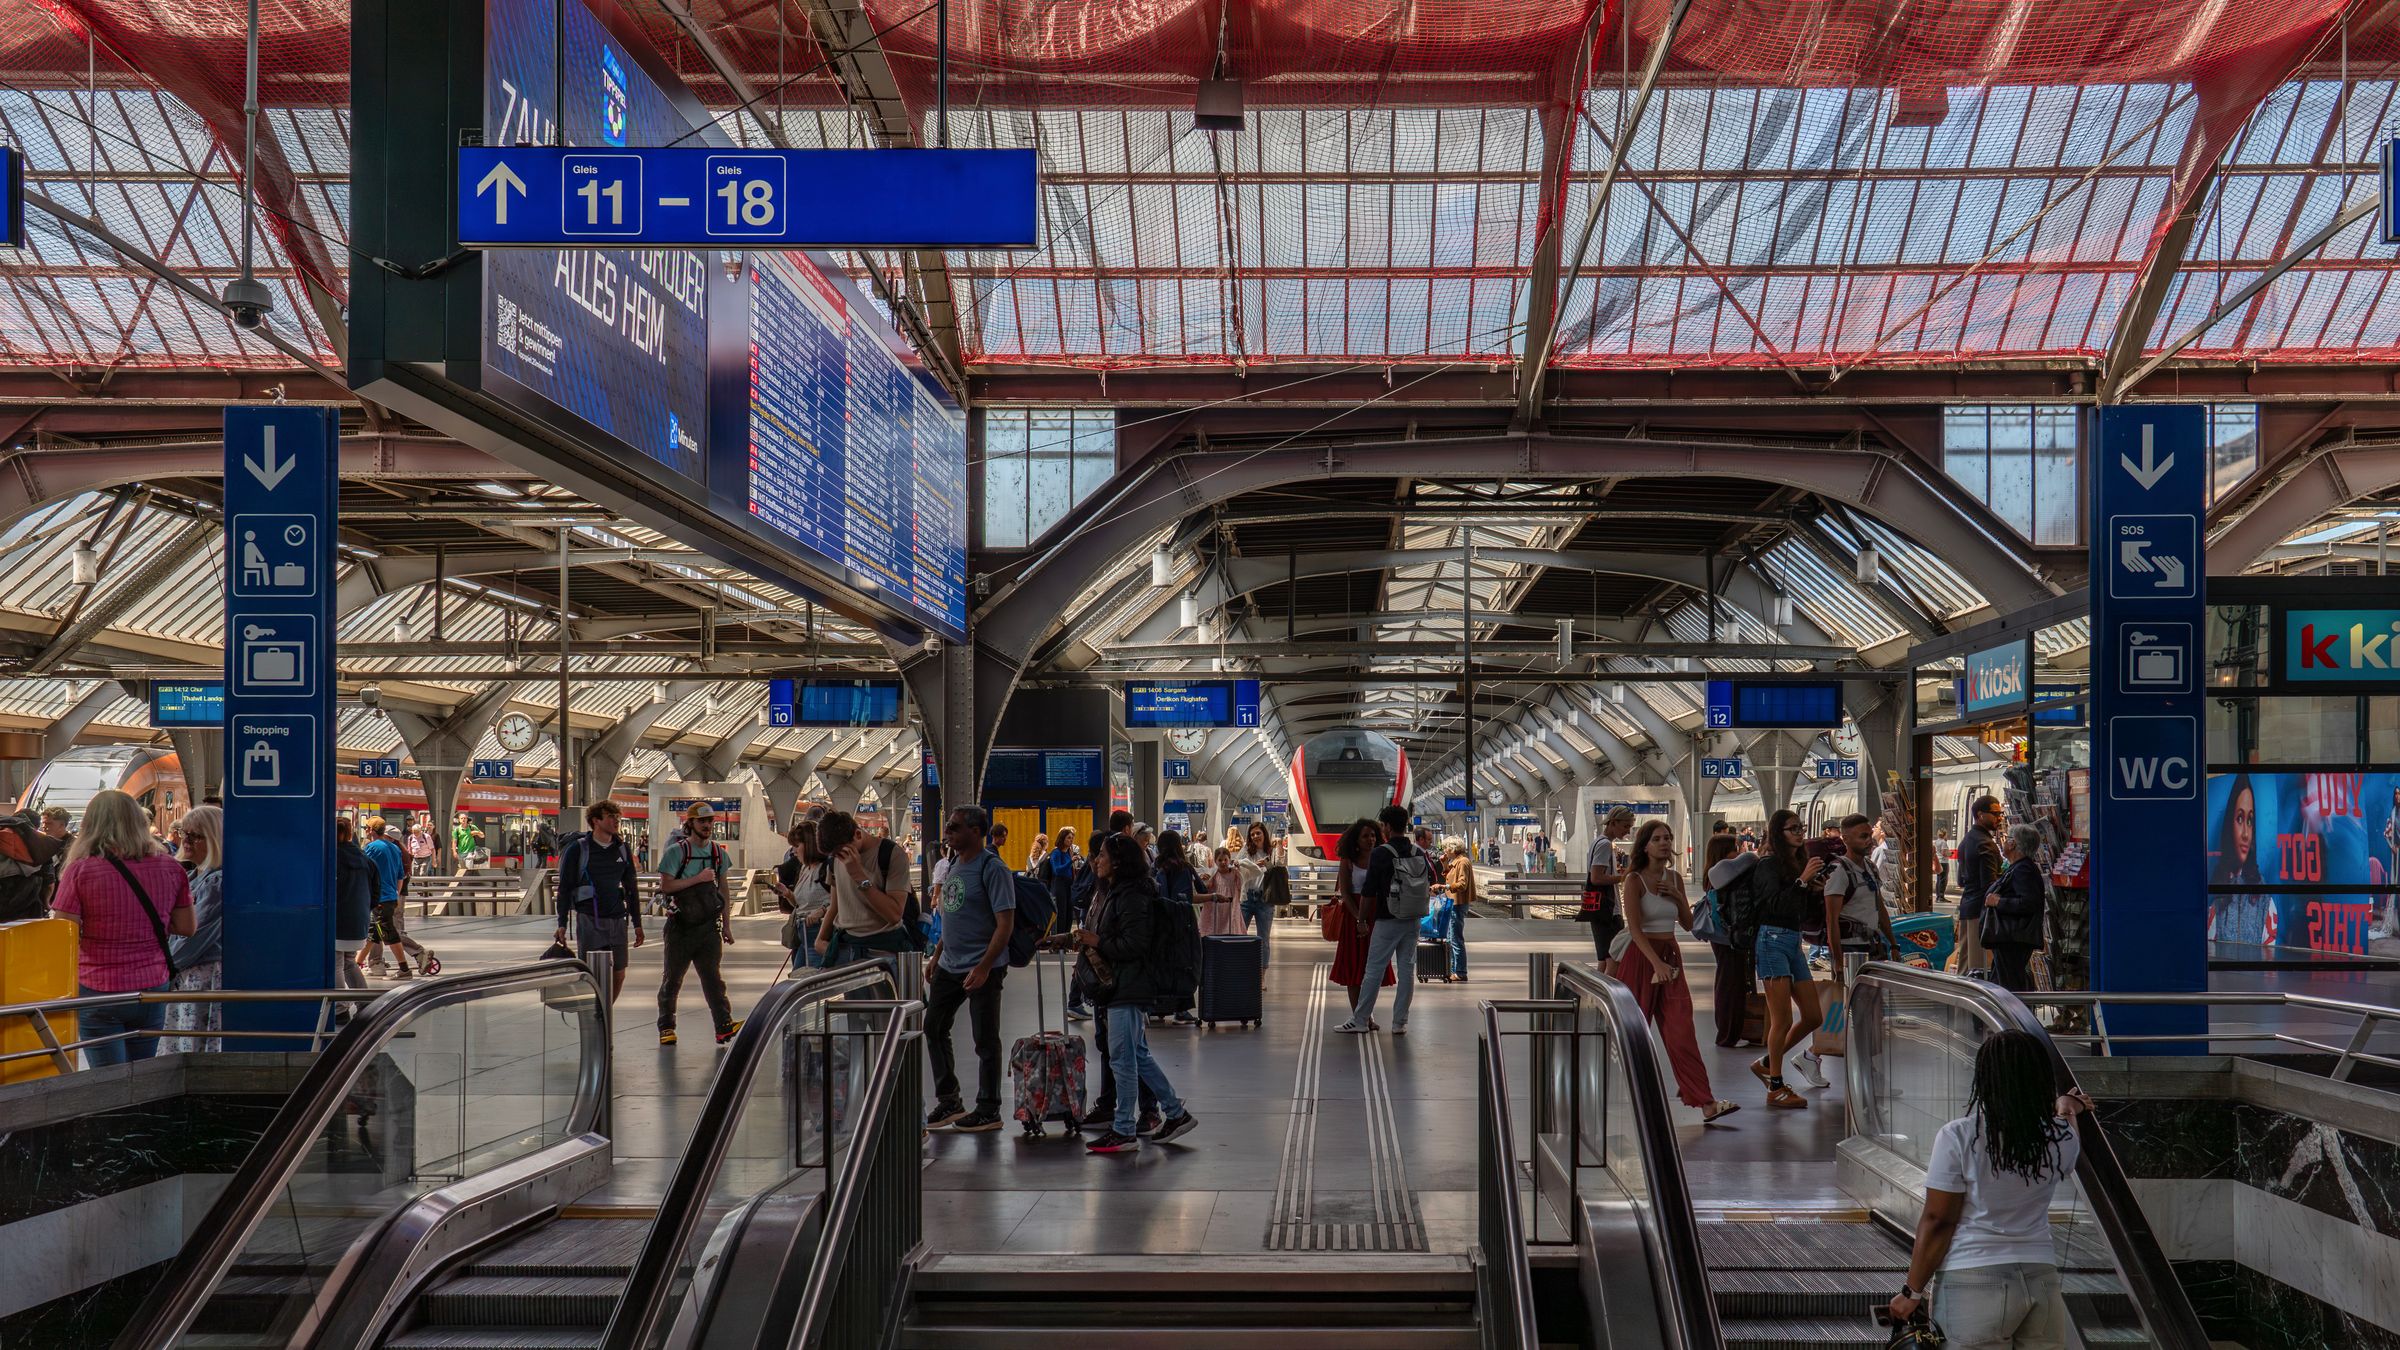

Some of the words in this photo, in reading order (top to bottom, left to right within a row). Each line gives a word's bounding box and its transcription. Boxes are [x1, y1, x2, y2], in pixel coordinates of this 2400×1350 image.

[573, 165, 598, 175] Gleis
[717, 166, 742, 175] Gleis
[577, 180, 622, 224] 11
[717, 179, 775, 226] 18
[553, 250, 617, 327] ALLES
[622, 274, 666, 365] HEIM.
[519, 309, 534, 331] Jetzt
[534, 317, 562, 350] mittippen
[519, 328, 524, 344] &
[525, 336, 555, 364] gewinnen!
[678, 428, 698, 454] Minuten
[2121, 525, 2144, 535] SOS
[2301, 623, 2340, 669] k
[1969, 664, 1978, 702] k
[1980, 655, 2022, 700] kiosk
[775, 712, 788, 723] 10
[1242, 713, 1253, 724] 11
[1713, 714, 1727, 724] 12
[243, 725, 289, 736] Shopping
[364, 765, 372, 775] 8
[384, 765, 393, 775] A
[479, 765, 488, 776] A
[500, 765, 508, 776] 9
[1175, 766, 1185, 776] 11
[1705, 764, 1718, 775] 12
[1727, 765, 1737, 775] A
[1823, 765, 1832, 776] A
[1841, 765, 1855, 776] 13
[2119, 757, 2189, 789] WC
